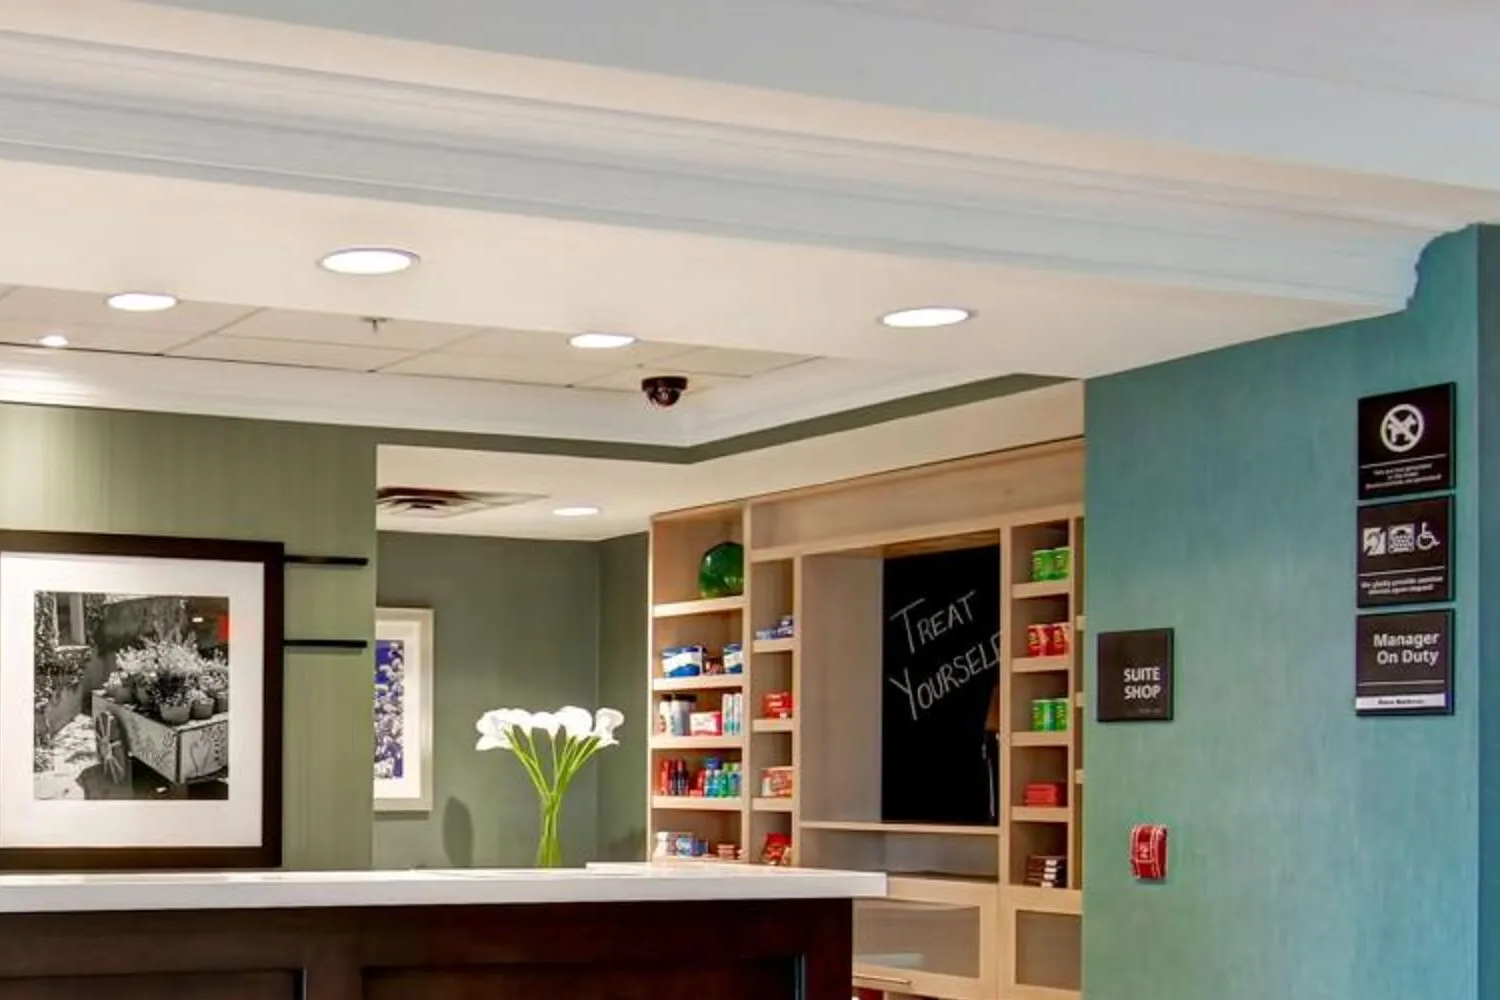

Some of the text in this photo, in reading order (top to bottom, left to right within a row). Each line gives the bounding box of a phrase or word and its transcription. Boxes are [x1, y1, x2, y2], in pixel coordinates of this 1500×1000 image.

[889, 589, 977, 654] TREAT
[1373, 633, 1440, 649] Manager
[1377, 649, 1439, 667] On Duty
[1123, 666, 1161, 682] SUITE
[1123, 685, 1162, 700] SHOP
